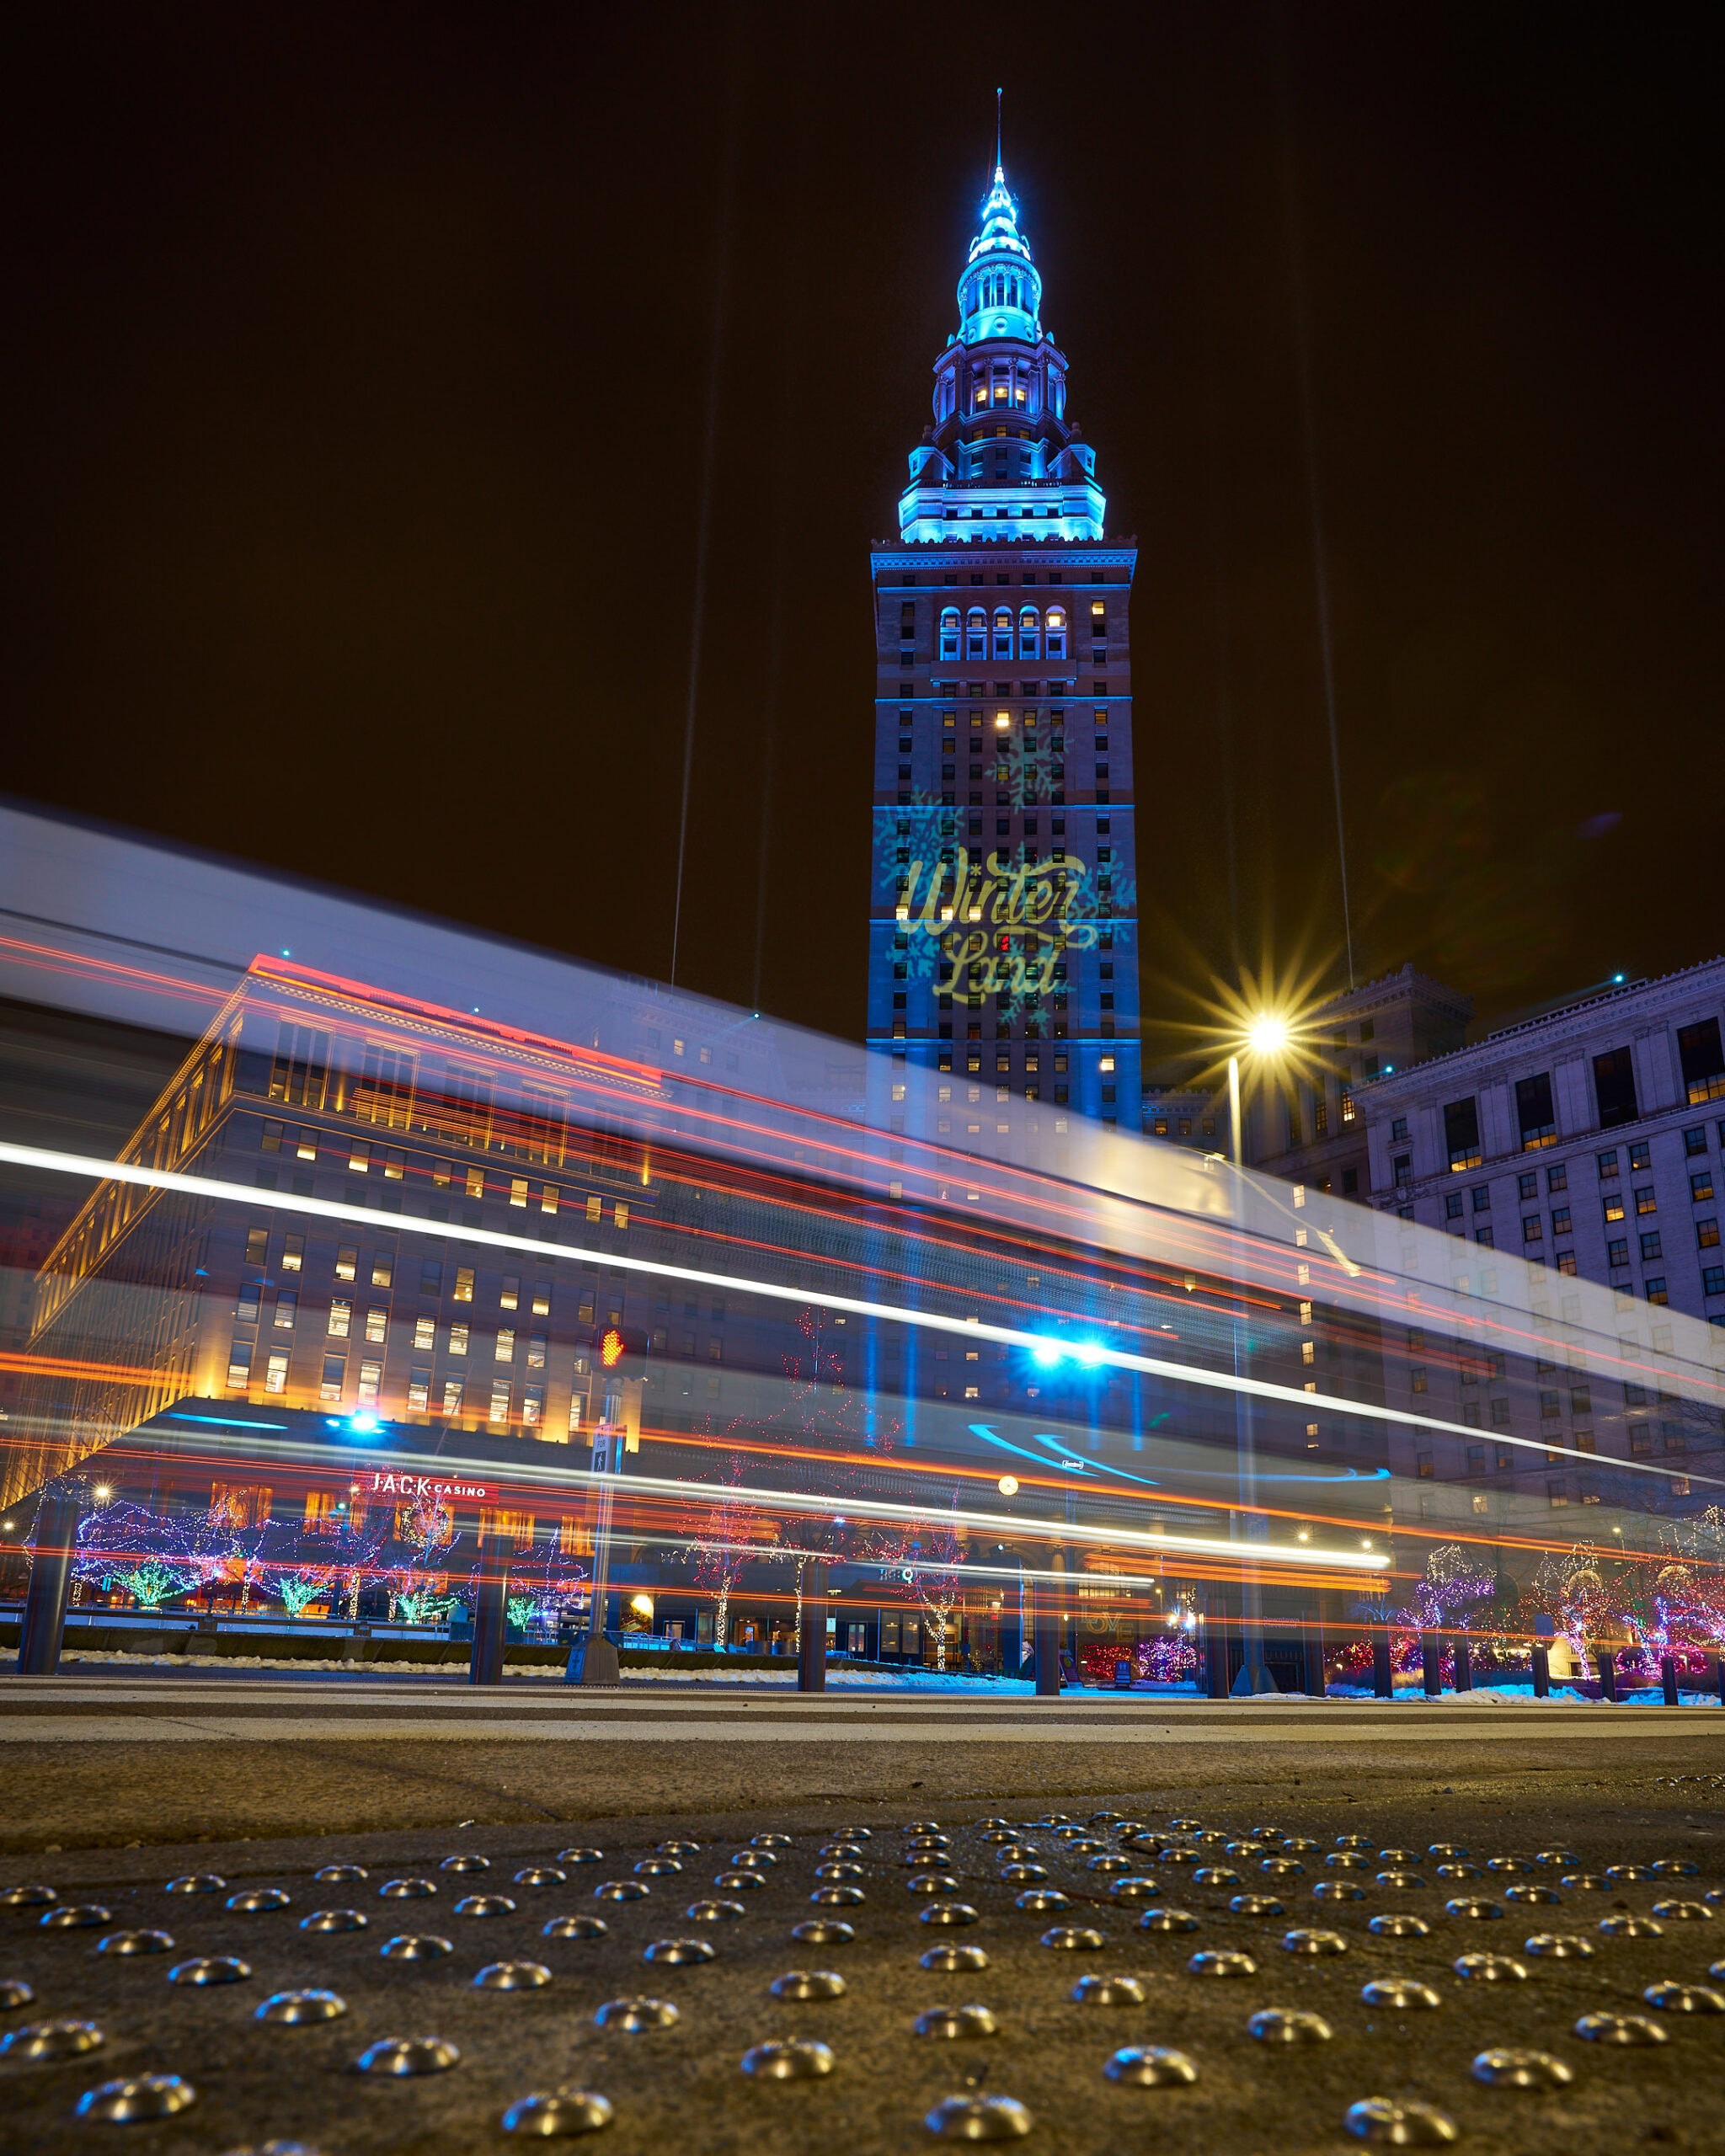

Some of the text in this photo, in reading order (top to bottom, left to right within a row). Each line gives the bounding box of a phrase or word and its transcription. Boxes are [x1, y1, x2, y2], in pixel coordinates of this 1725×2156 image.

[898, 846, 1097, 939] Winter
[932, 929, 1062, 1004] Land
[435, 1485, 486, 1497] CASINO
